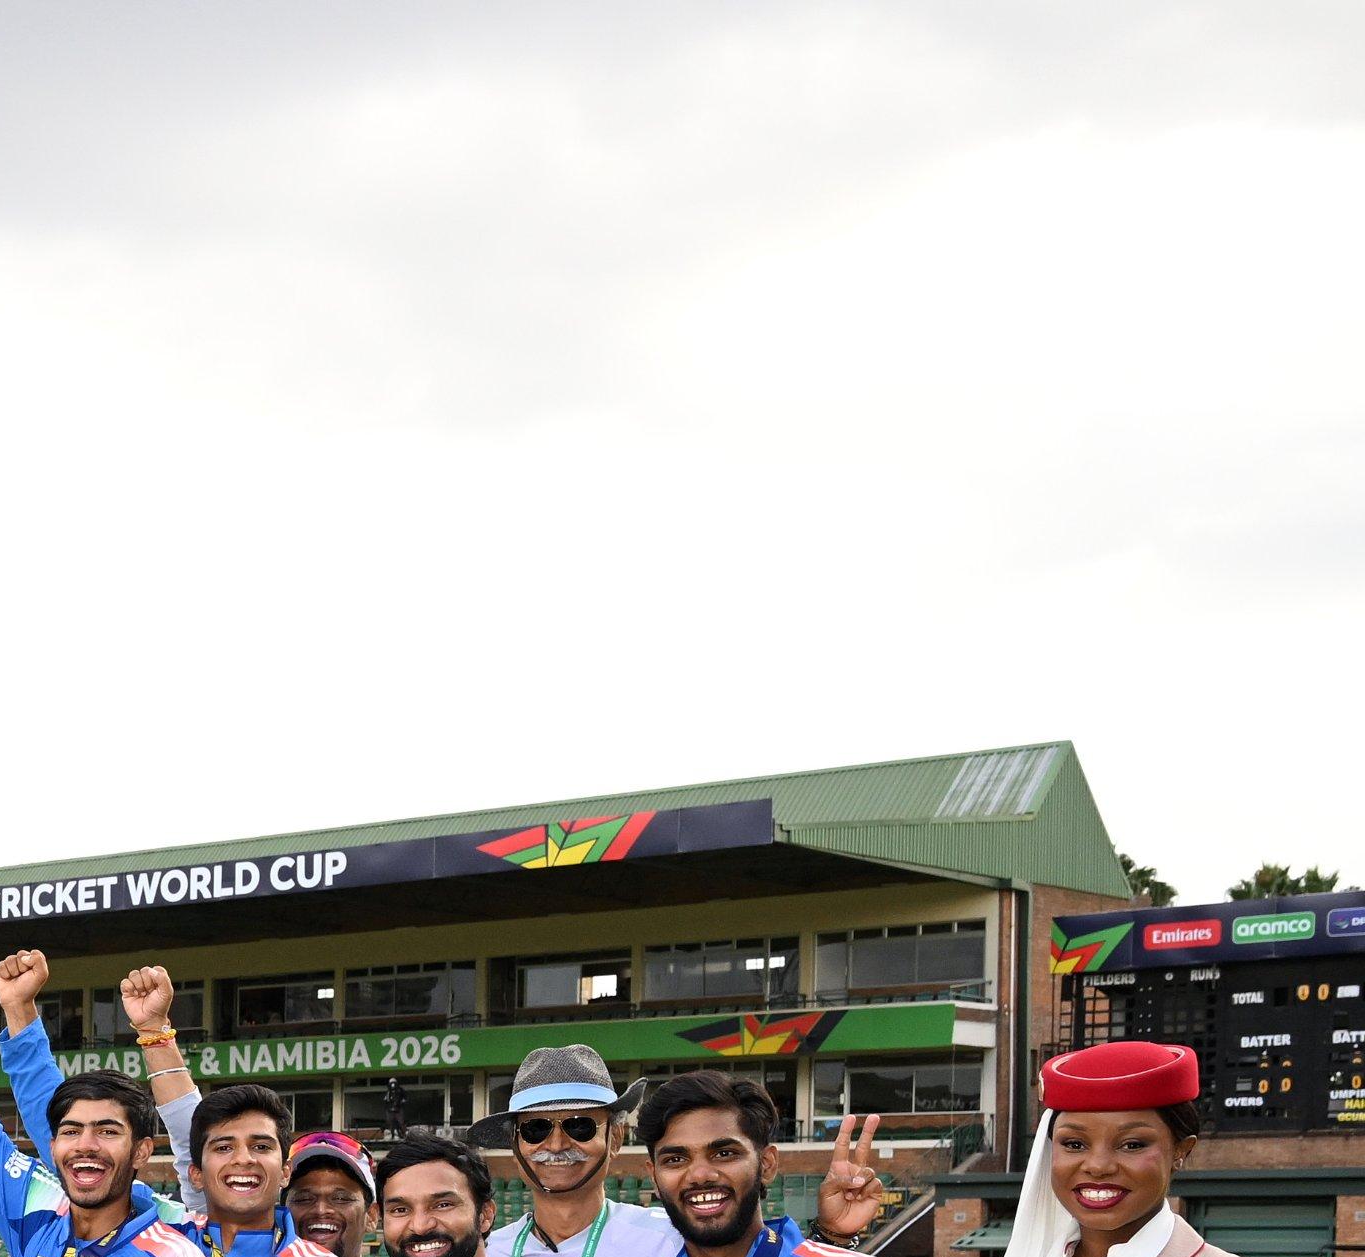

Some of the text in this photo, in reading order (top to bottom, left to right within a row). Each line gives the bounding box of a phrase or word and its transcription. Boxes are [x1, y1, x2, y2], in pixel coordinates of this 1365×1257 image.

[126, 860, 261, 906] WORLD
[269, 851, 348, 891] CUP
[1237, 917, 1312, 936] aramco
[1152, 927, 1213, 944] Emirates
[1083, 973, 1137, 987] FIELDERS
[1232, 992, 1265, 1005] TOTAL
[1241, 1034, 1291, 1049] BATTER
[200, 1047, 221, 1076] &
[229, 1038, 371, 1074] NAMIBIA
[380, 1034, 462, 1066] 2026
[1225, 1095, 1264, 1108] OVERS
